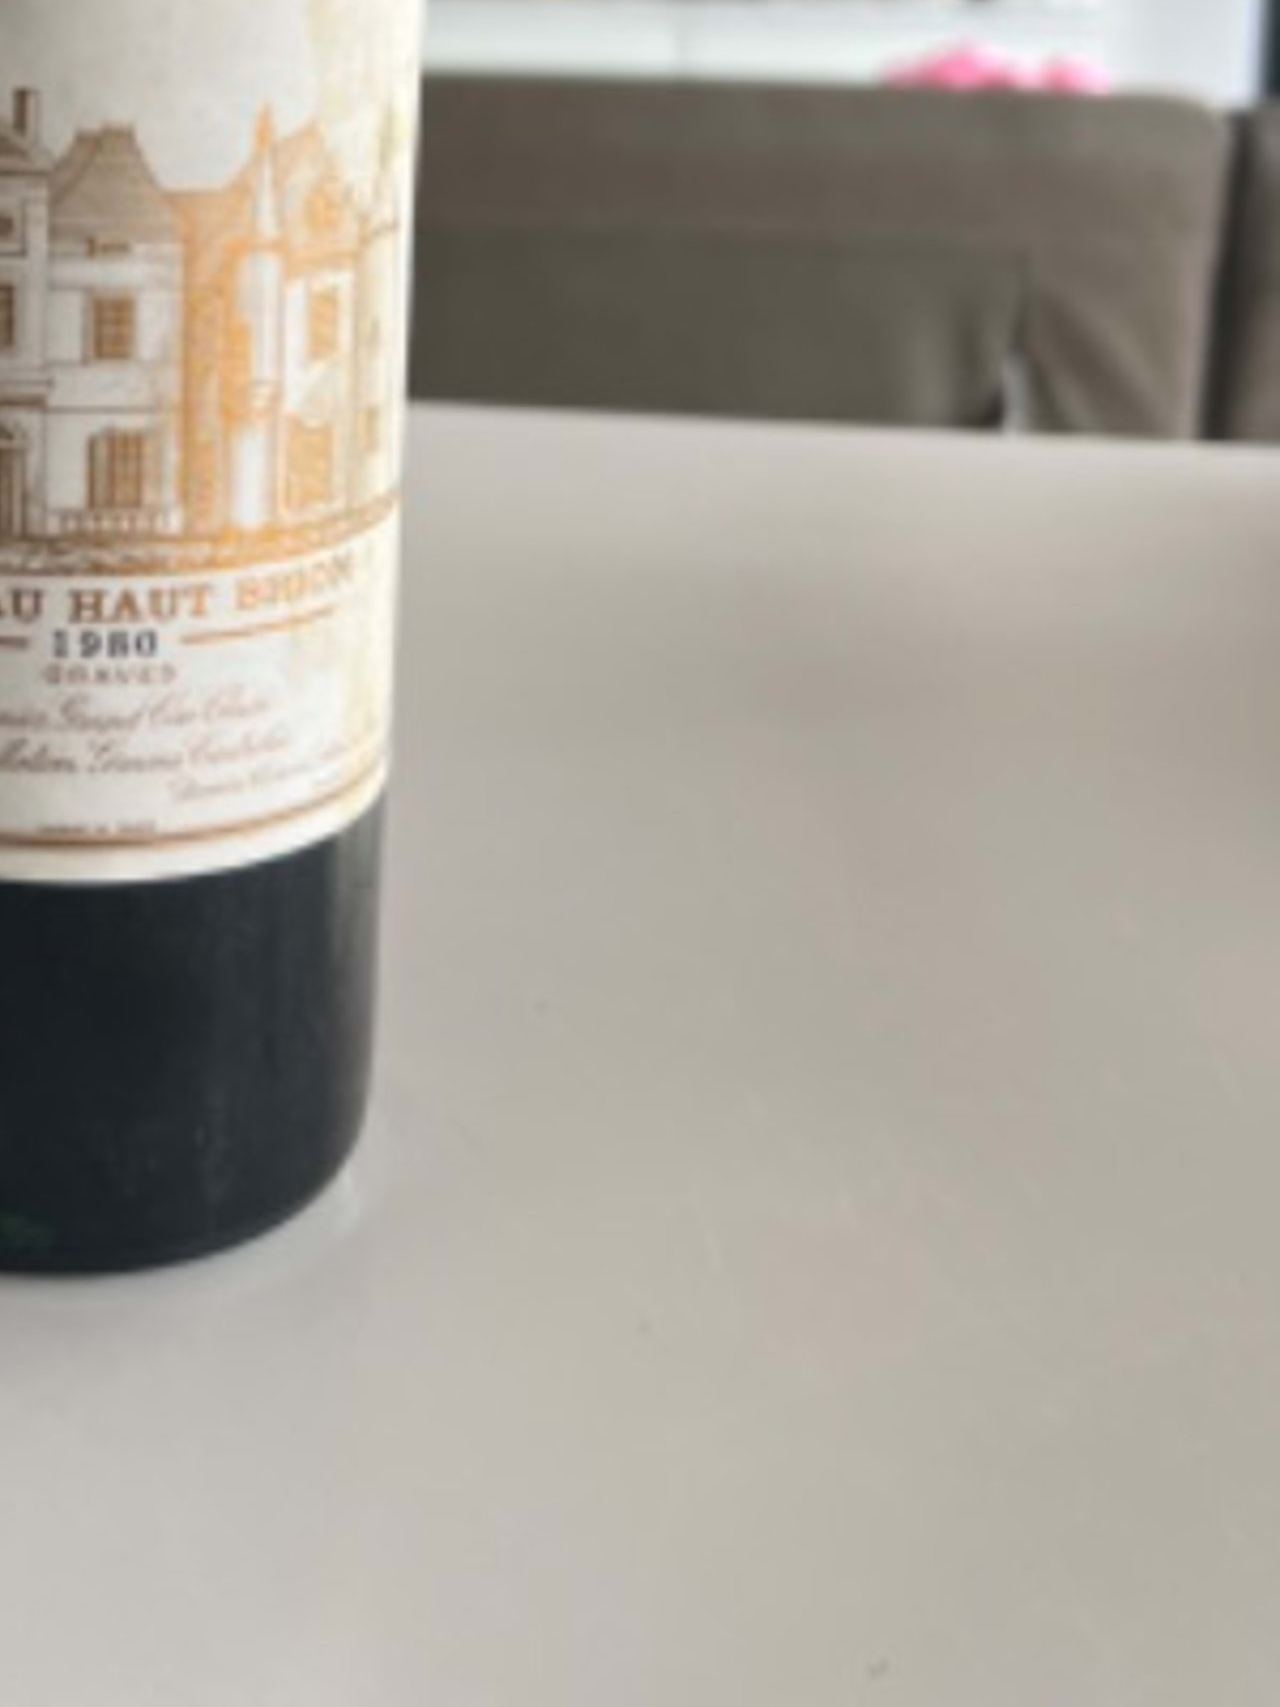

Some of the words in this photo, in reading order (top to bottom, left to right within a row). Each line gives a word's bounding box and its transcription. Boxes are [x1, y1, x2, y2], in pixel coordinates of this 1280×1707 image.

[67, 581, 212, 625] HAUT
[234, 550, 354, 612] BRION
[51, 628, 158, 659] 1980
